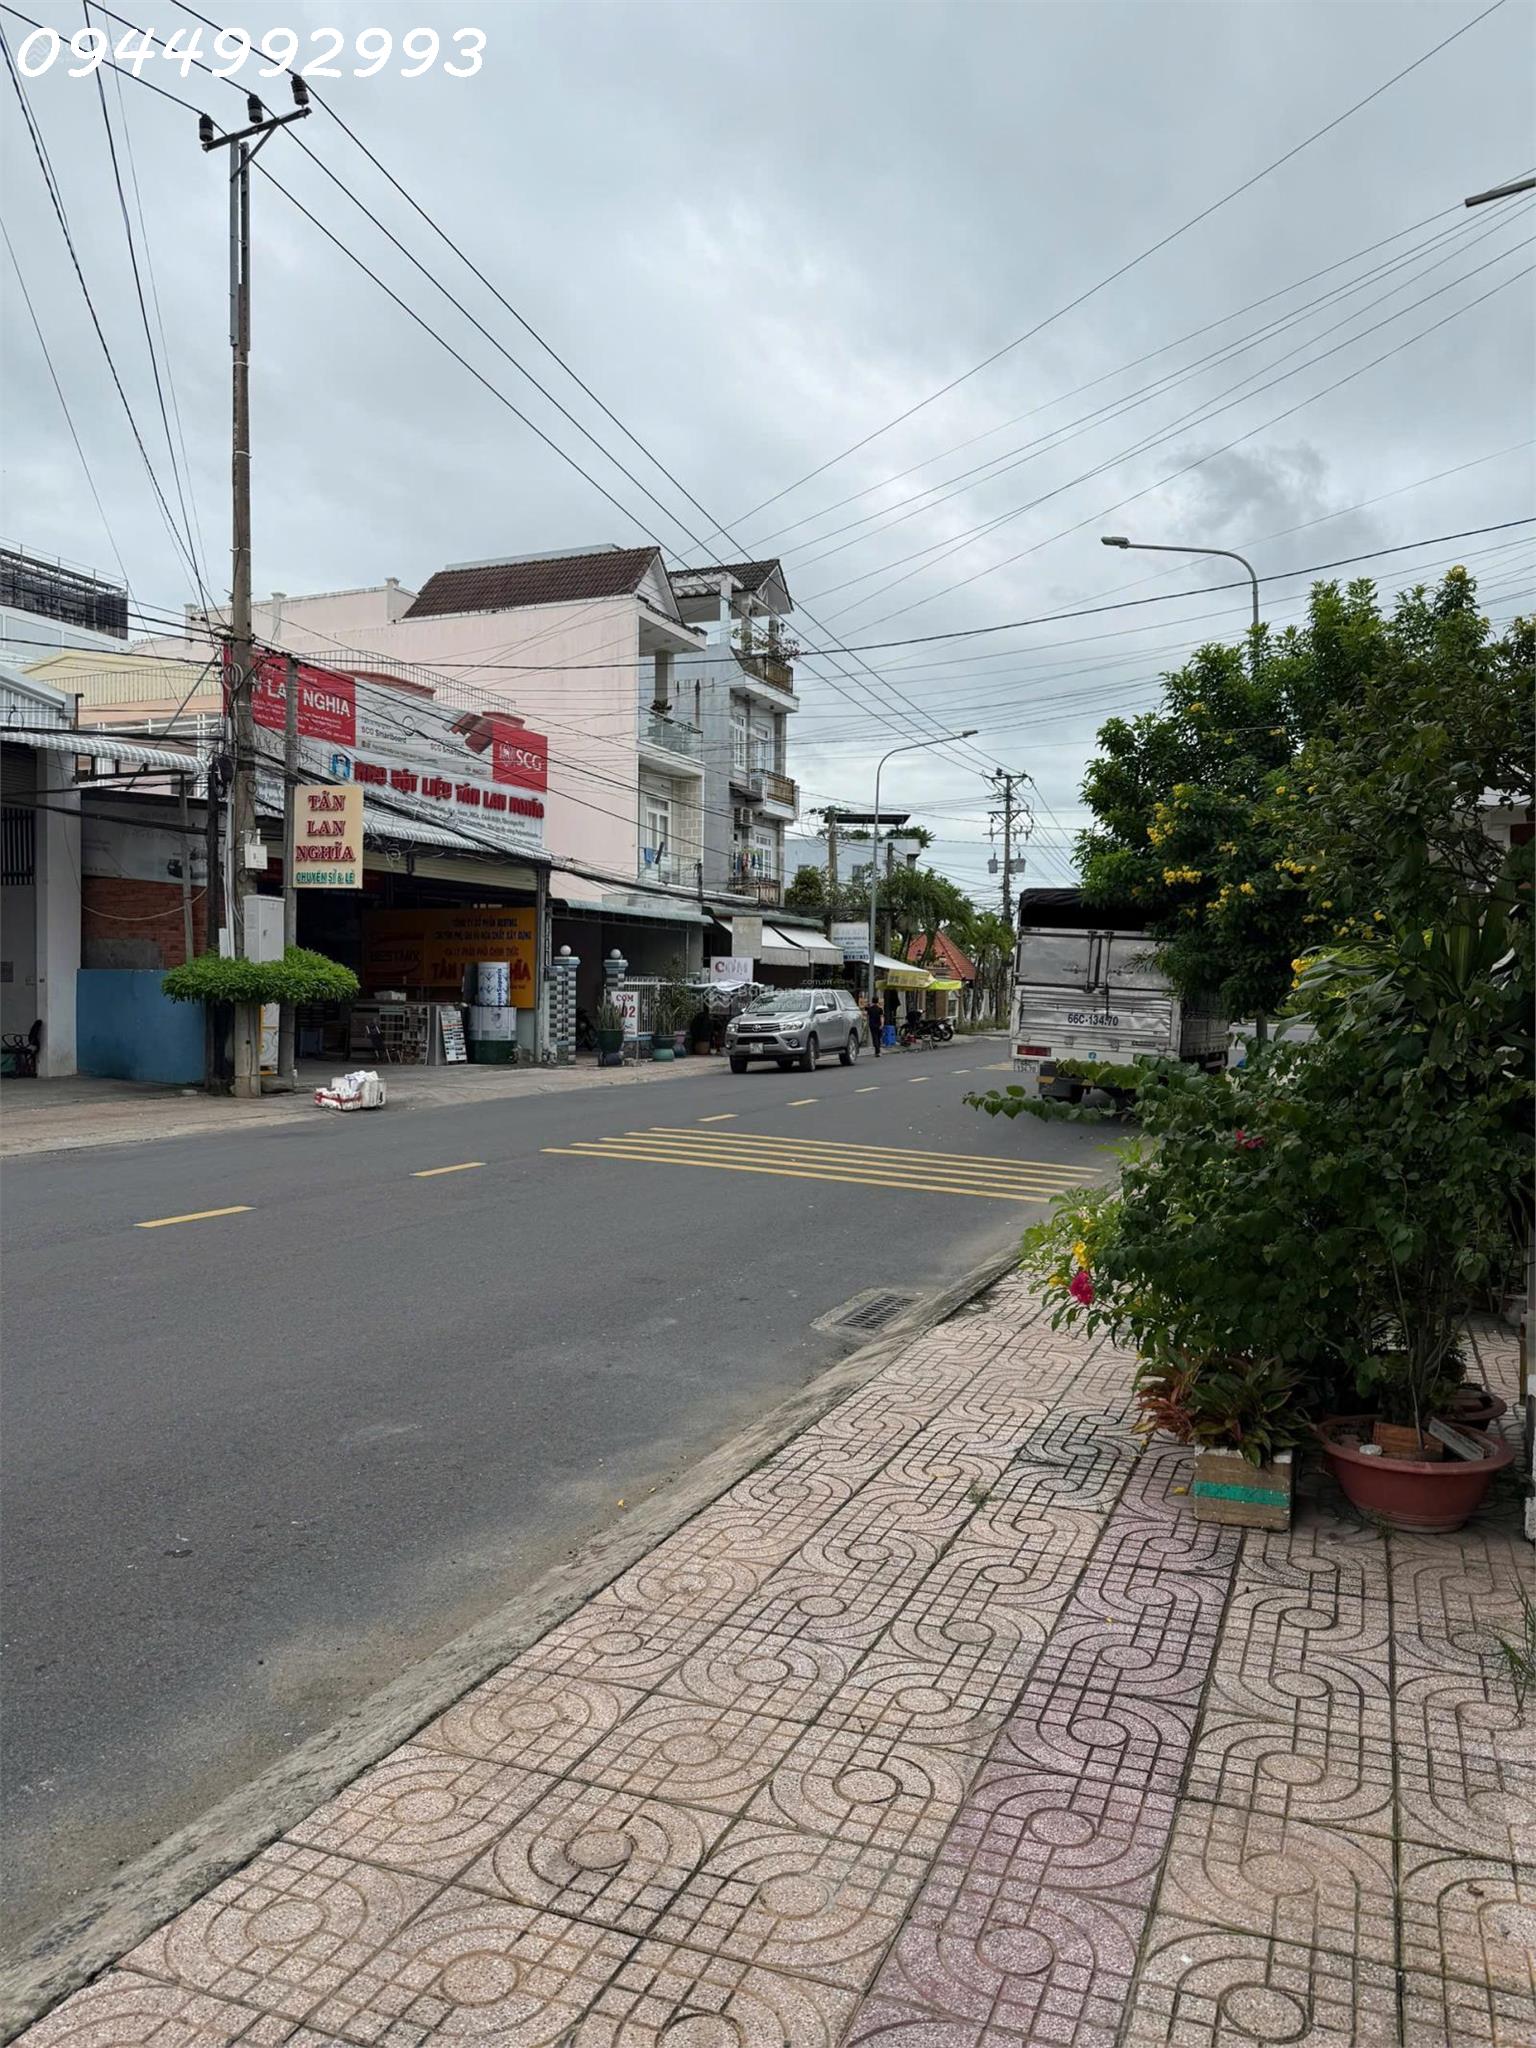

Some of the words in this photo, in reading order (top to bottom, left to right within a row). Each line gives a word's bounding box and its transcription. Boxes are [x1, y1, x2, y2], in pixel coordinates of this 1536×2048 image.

[516, 749, 543, 771] SCG
[483, 791, 507, 811] LAN
[307, 820, 346, 837] LAN
[295, 841, 356, 862] NGHĨA
